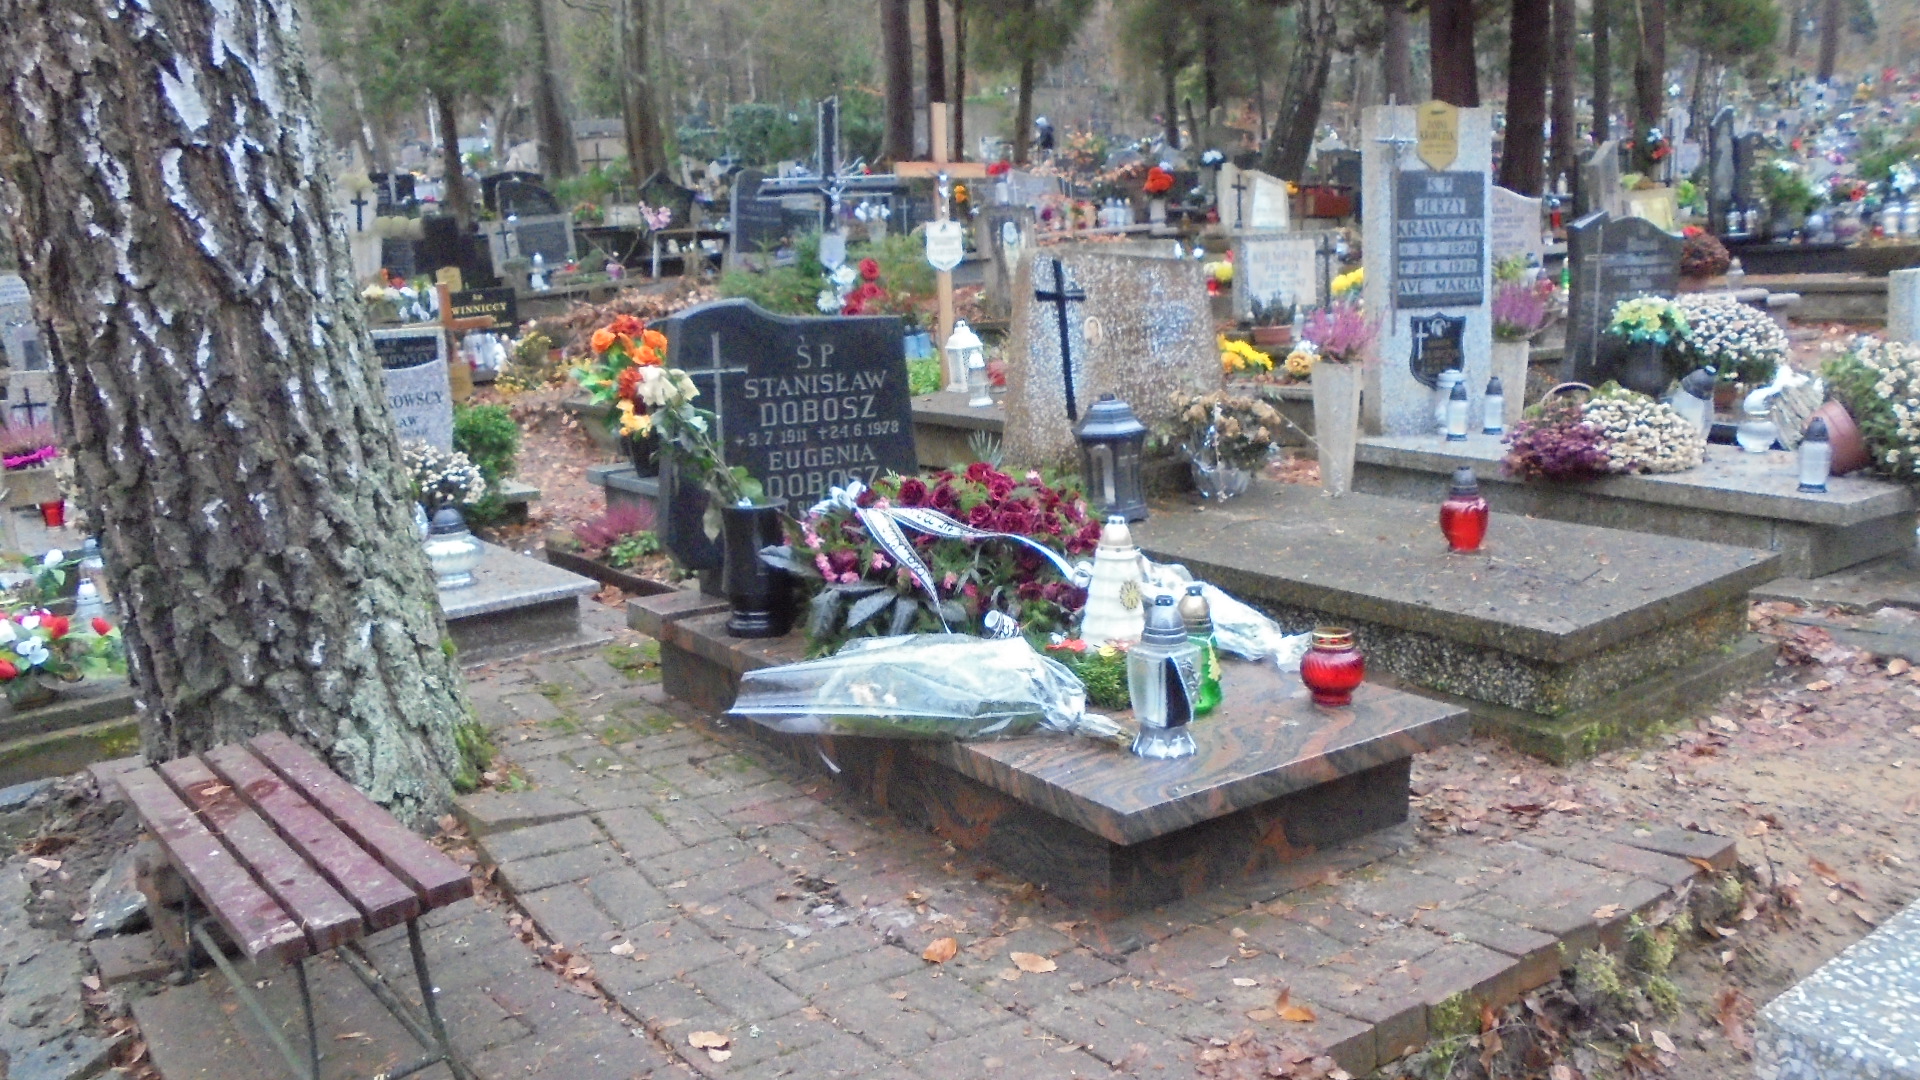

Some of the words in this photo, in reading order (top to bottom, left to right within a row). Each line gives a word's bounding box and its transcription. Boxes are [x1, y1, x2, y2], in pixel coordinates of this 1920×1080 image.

[1419, 198, 1462, 214] JERZY
[1397, 220, 1482, 237] KRAWCZYK
[1399, 280, 1423, 293] AVE
[1436, 278, 1480, 292] MARIA
[451, 302, 507, 315] WINNICCY
[743, 369, 888, 399] STANISŁAW
[759, 394, 878, 427] DOBOSZ
[768, 442, 877, 472] EUGENIA
